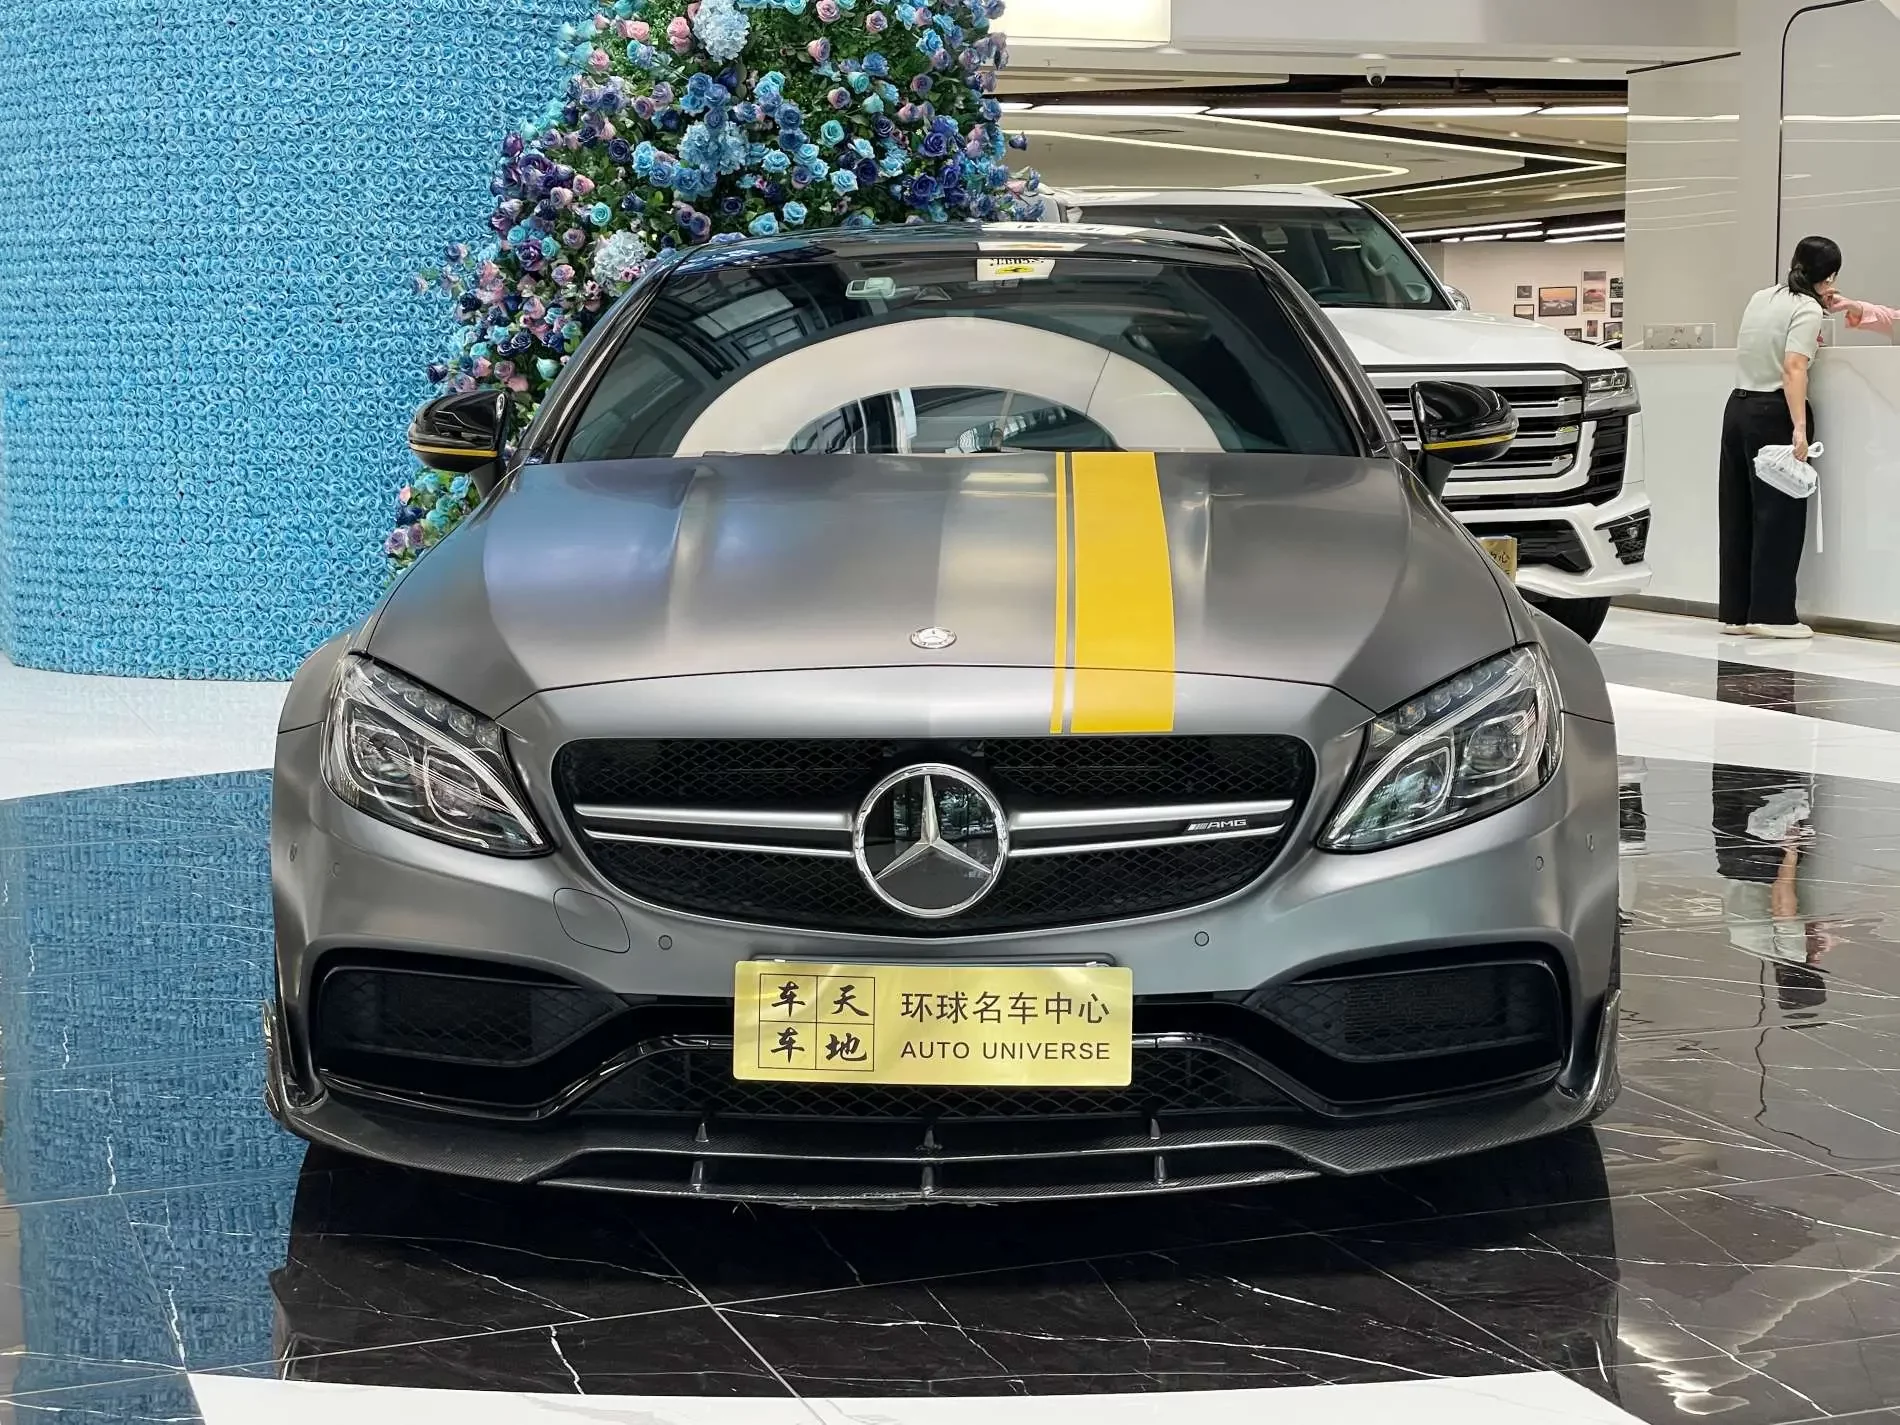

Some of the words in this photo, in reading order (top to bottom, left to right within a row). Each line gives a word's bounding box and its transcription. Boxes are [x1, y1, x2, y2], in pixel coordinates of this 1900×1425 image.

[1206, 819, 1247, 829] AMG
[900, 991, 1110, 1025] 环球名车中心
[900, 1041, 970, 1060] AUTO
[983, 1042, 1110, 1060] UNIVERSE
